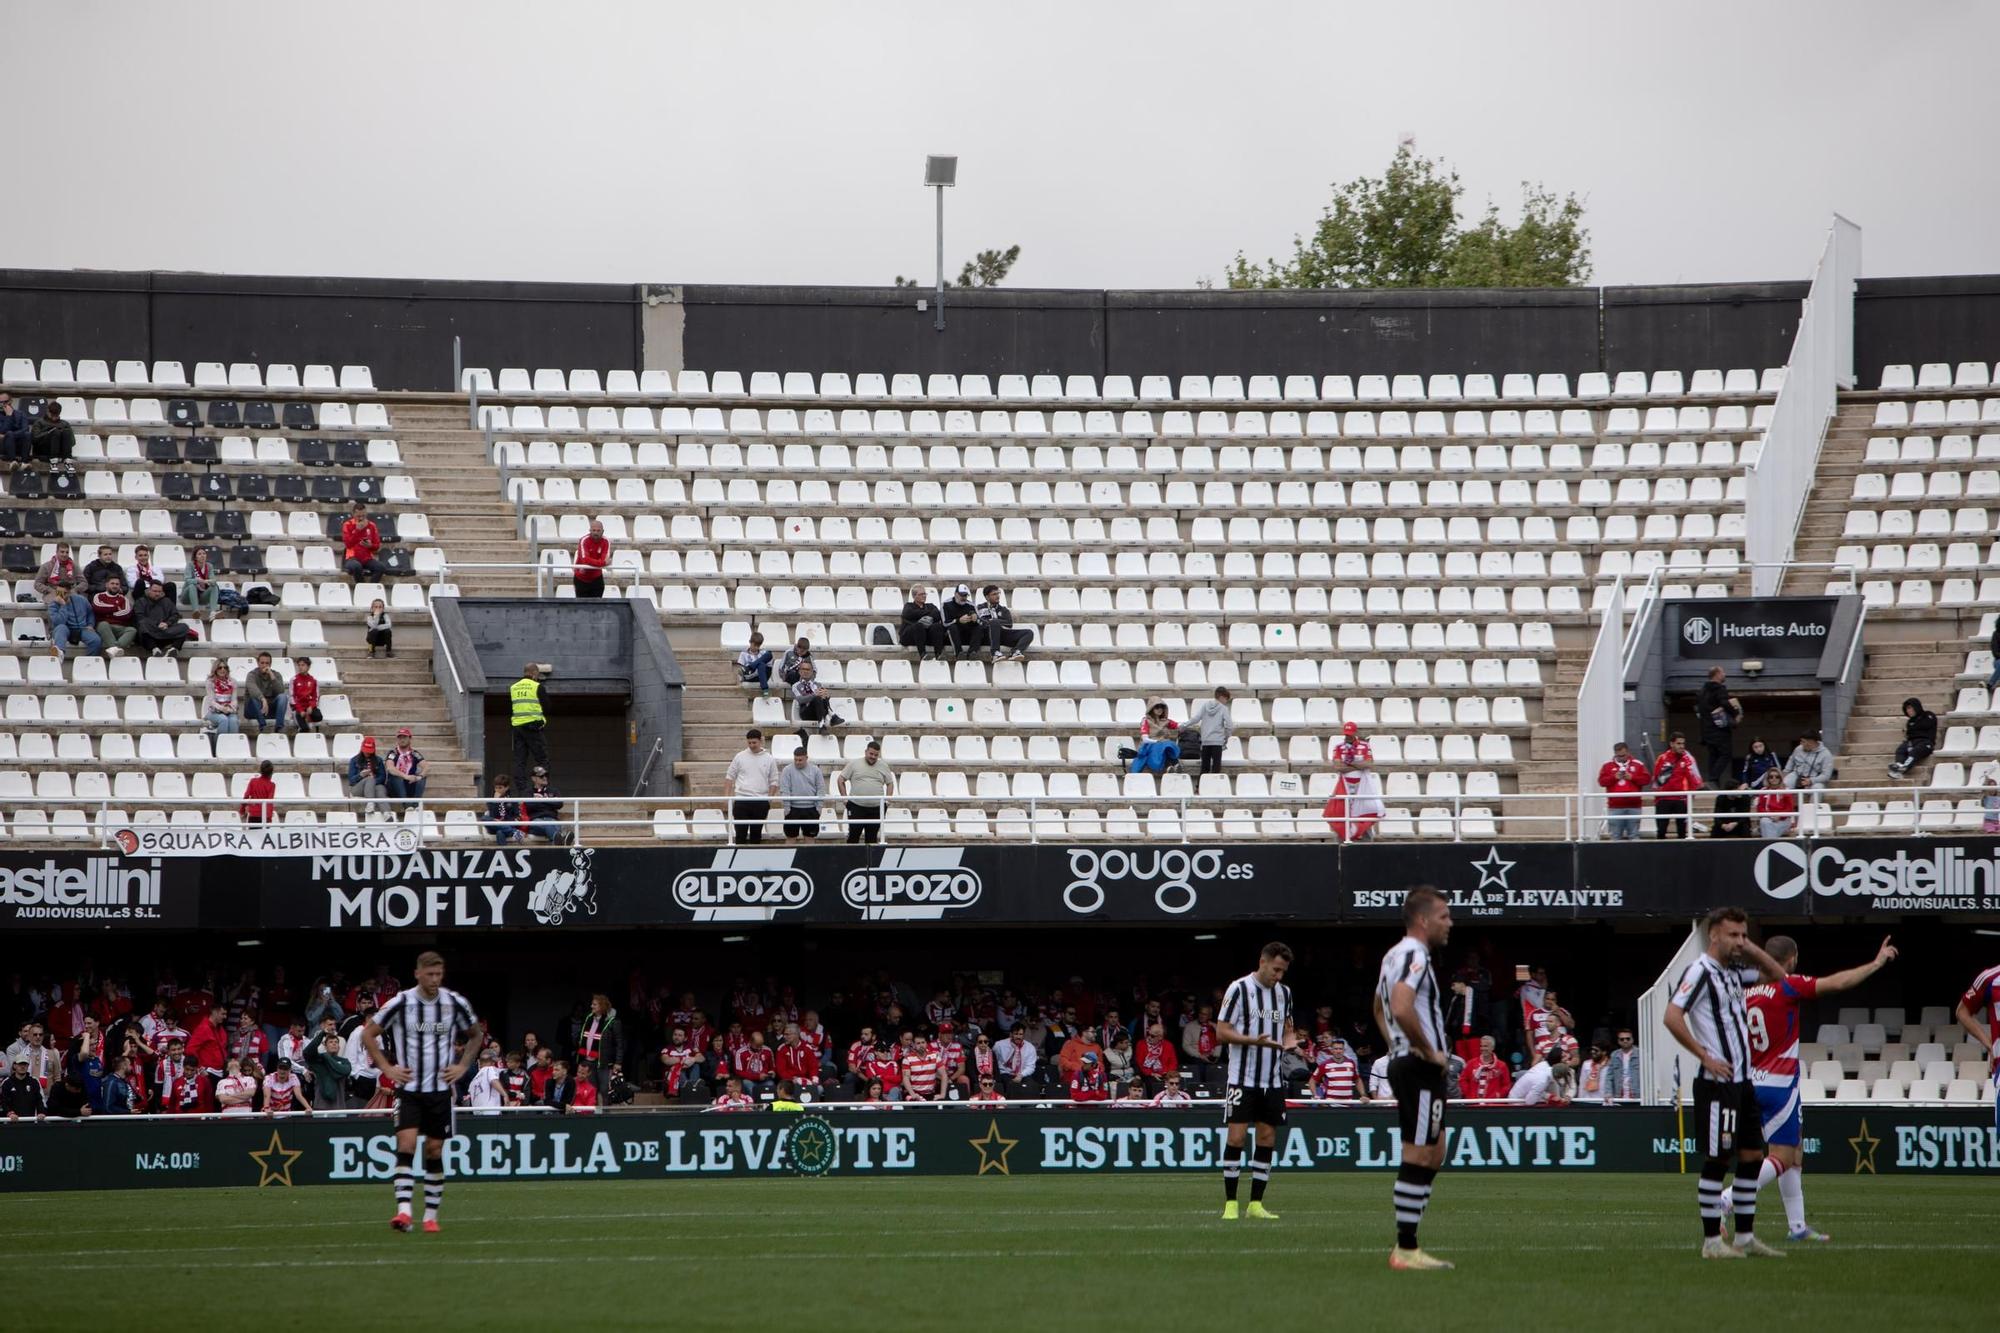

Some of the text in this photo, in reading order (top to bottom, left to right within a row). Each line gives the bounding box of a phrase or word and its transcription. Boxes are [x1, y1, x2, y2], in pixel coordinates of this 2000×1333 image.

[1684, 618, 1826, 643] MG Huertas Auto
[142, 832, 252, 850] SQUADRA
[261, 831, 390, 850] ALBINEGRA
[312, 850, 532, 880] MUDANZAS
[1810, 846, 2000, 896] Castellini
[0, 857, 161, 905] astellini
[1063, 849, 1254, 913] gougo.es
[327, 885, 515, 927] MOFLY
[1353, 890, 1623, 907] ESTLA DE LEVANTE
[134, 907, 161, 918] S.L.
[1747, 1006, 1770, 1053] 9
[1227, 1088, 1243, 1106] 22
[1432, 1100, 1443, 1122] 9
[1722, 1108, 1736, 1133] 11
[624, 1141, 659, 1162] DE
[665, 1127, 915, 1171] LEVATE
[1316, 1137, 1350, 1157] DE
